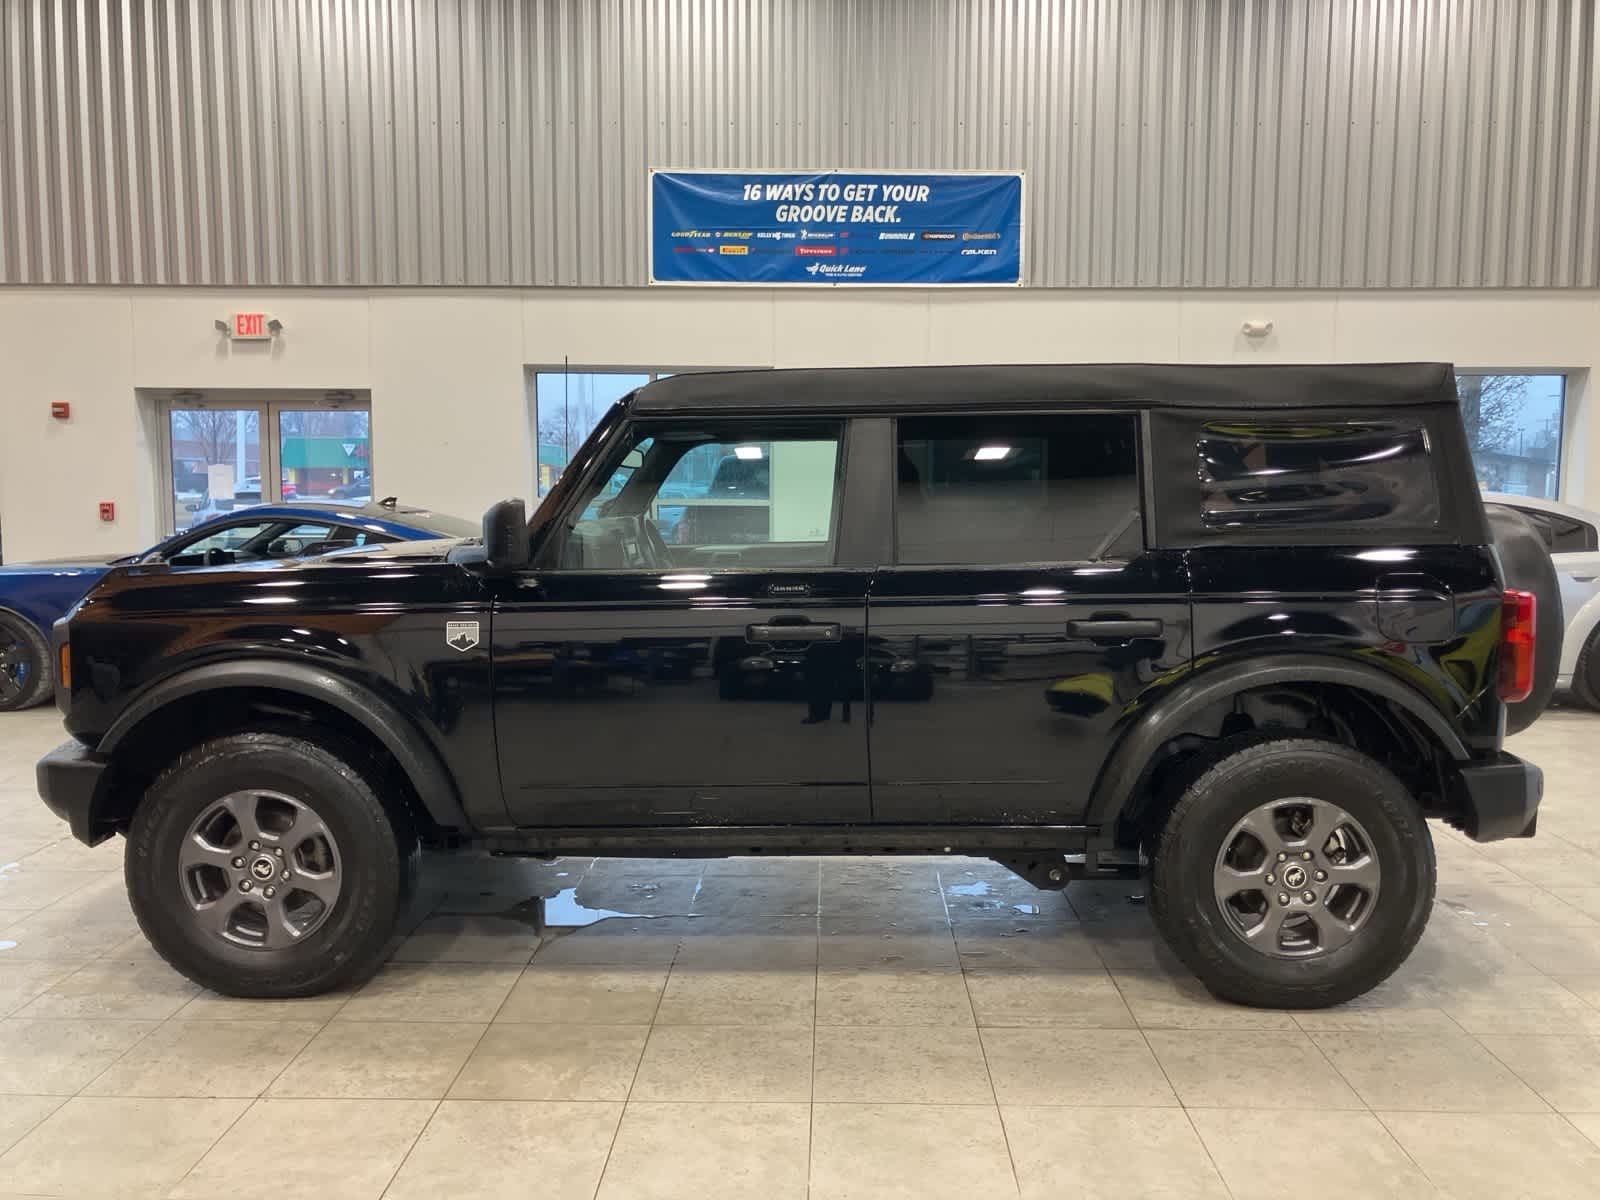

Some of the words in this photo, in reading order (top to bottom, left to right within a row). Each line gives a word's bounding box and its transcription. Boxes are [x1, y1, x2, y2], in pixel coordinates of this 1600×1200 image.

[743, 184, 761, 201] 16
[766, 184, 815, 202] WAYS
[818, 184, 841, 202] TO
[843, 184, 877, 202] GET
[882, 185, 930, 202] YOUR
[776, 205, 849, 223] GROOVE
[851, 205, 901, 223] BACK.
[671, 230, 711, 238] GOODYEAR
[819, 264, 844, 273] Quick
[844, 264, 866, 273] Lane
[236, 314, 264, 336] EXIT
